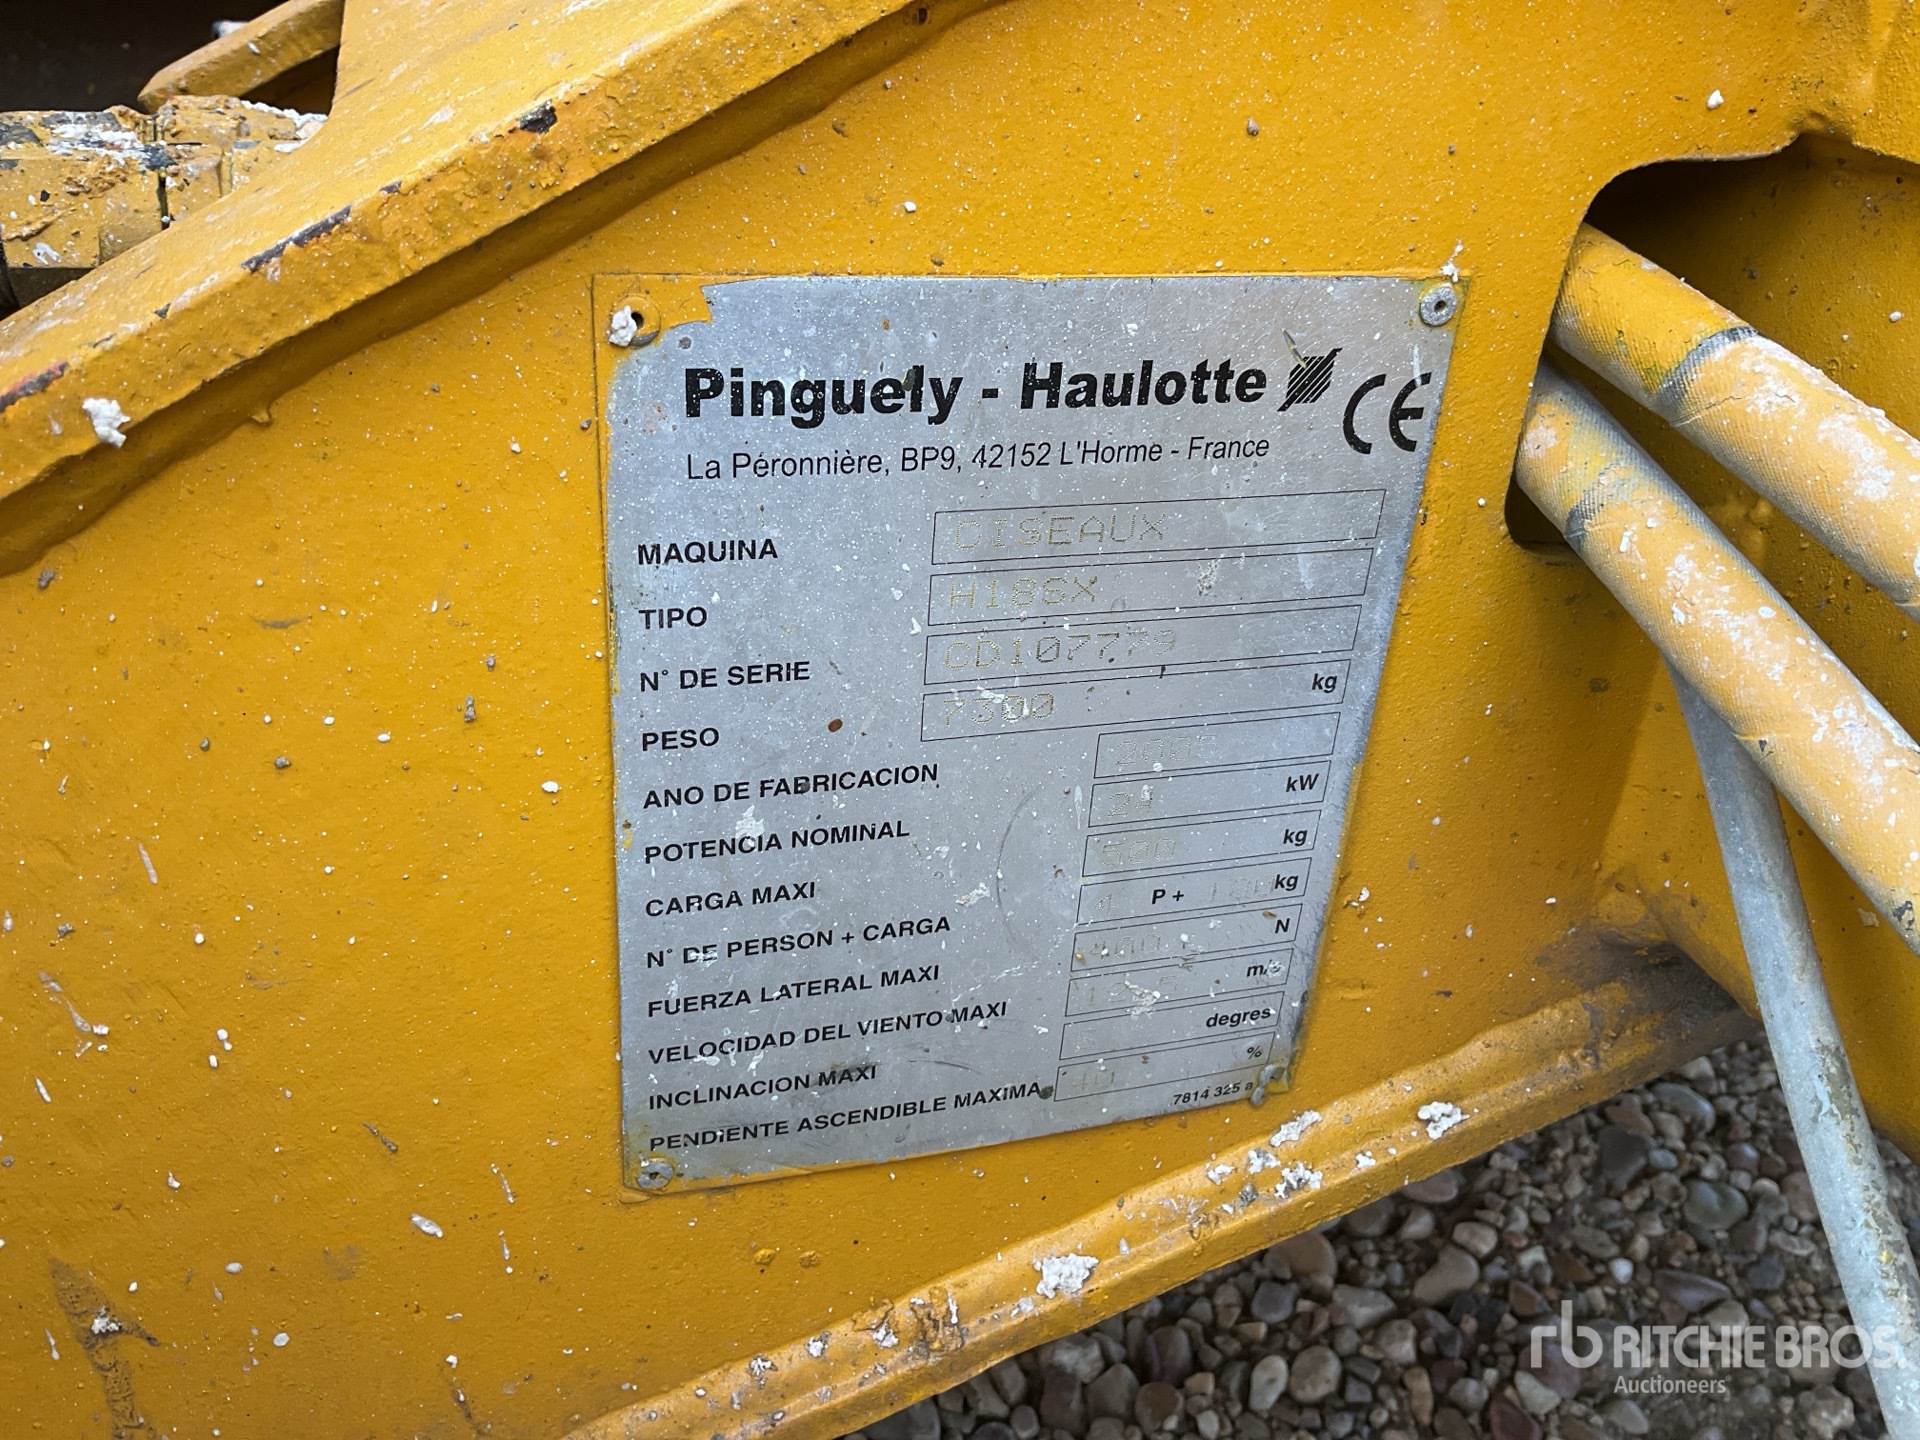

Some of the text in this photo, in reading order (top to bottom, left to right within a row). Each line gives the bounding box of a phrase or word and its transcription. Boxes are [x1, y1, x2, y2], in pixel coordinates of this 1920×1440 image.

[685, 365, 963, 429] Pinguely
[1020, 358, 1267, 409] Haulotte
[1343, 372, 1432, 454] CE
[687, 454, 720, 479] La
[733, 450, 890, 478] Péronnière,
[901, 446, 962, 474] BP9,
[972, 442, 1051, 468] 42152
[1060, 439, 1163, 465] L'Horme
[1187, 436, 1270, 461] France
[955, 513, 1167, 550] CISEAUX
[637, 538, 778, 564] MAQUINA
[639, 606, 707, 629] TIPO
[680, 668, 717, 690] DE
[727, 661, 810, 686] SERIE
[1312, 673, 1337, 693] kg
[642, 727, 719, 751] PESO
[643, 763, 939, 809] ANO DE FABRICACION
[1286, 774, 1319, 793] kW
[645, 821, 910, 864] POTENCIA NOMINAL
[1283, 828, 1307, 846] kg
[646, 882, 815, 917] CARGA MAXI
[1152, 889, 1166, 905] P
[1274, 874, 1299, 891] kg
[683, 944, 717, 964] DE
[727, 930, 832, 958] PERSON
[863, 917, 951, 942] CARGA
[1275, 918, 1290, 934] N
[648, 964, 939, 1017] FUERZA LATERAL MAXI
[649, 1001, 1007, 1064] VELOCIDAD DEL VIENTO MAXI
[1206, 1007, 1271, 1028] degres
[1247, 1046, 1262, 1058] %
[649, 1065, 876, 1110] INCLINACION MAXI
[1173, 1089, 1209, 1105] 7814
[1214, 1084, 1241, 1097] 325
[650, 1081, 1042, 1151] PENDIENTE ASCENDIBLE MAXIMA
